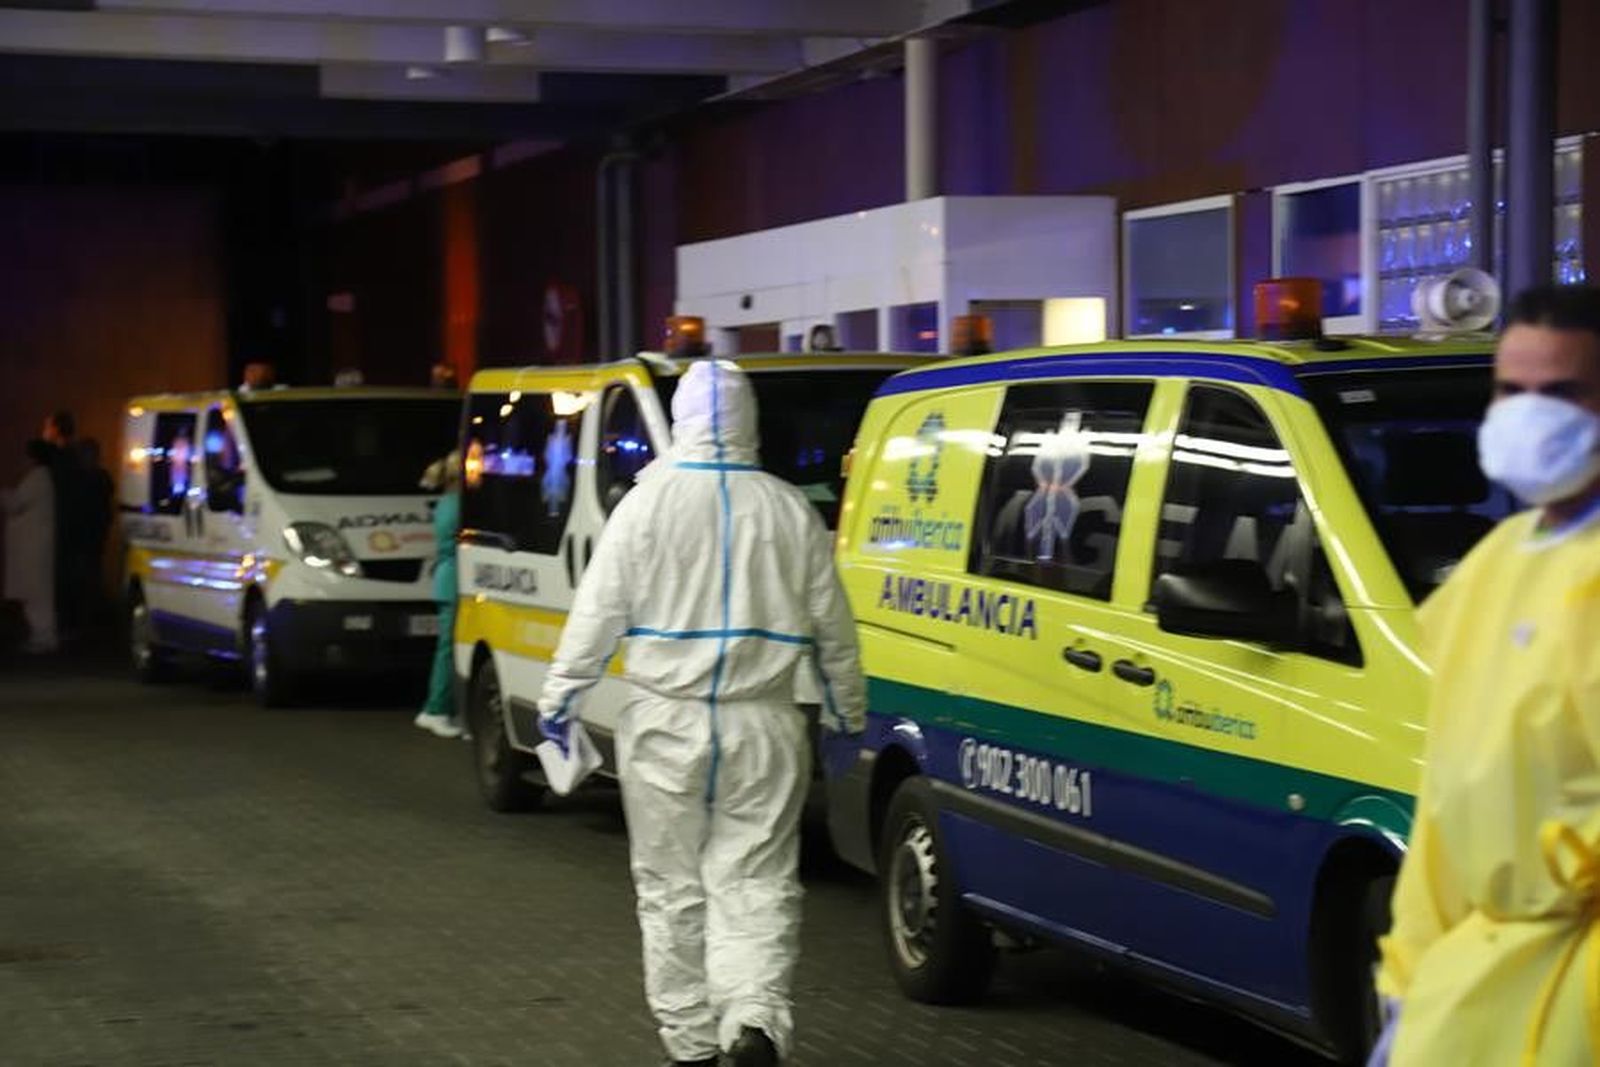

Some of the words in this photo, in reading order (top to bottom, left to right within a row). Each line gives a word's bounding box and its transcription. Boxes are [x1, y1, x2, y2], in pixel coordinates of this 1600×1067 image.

[877, 574, 1038, 641] AMBULANCIA
[976, 743, 1013, 795] 902
[1014, 753, 1052, 805] 300
[1053, 764, 1092, 818] 061
